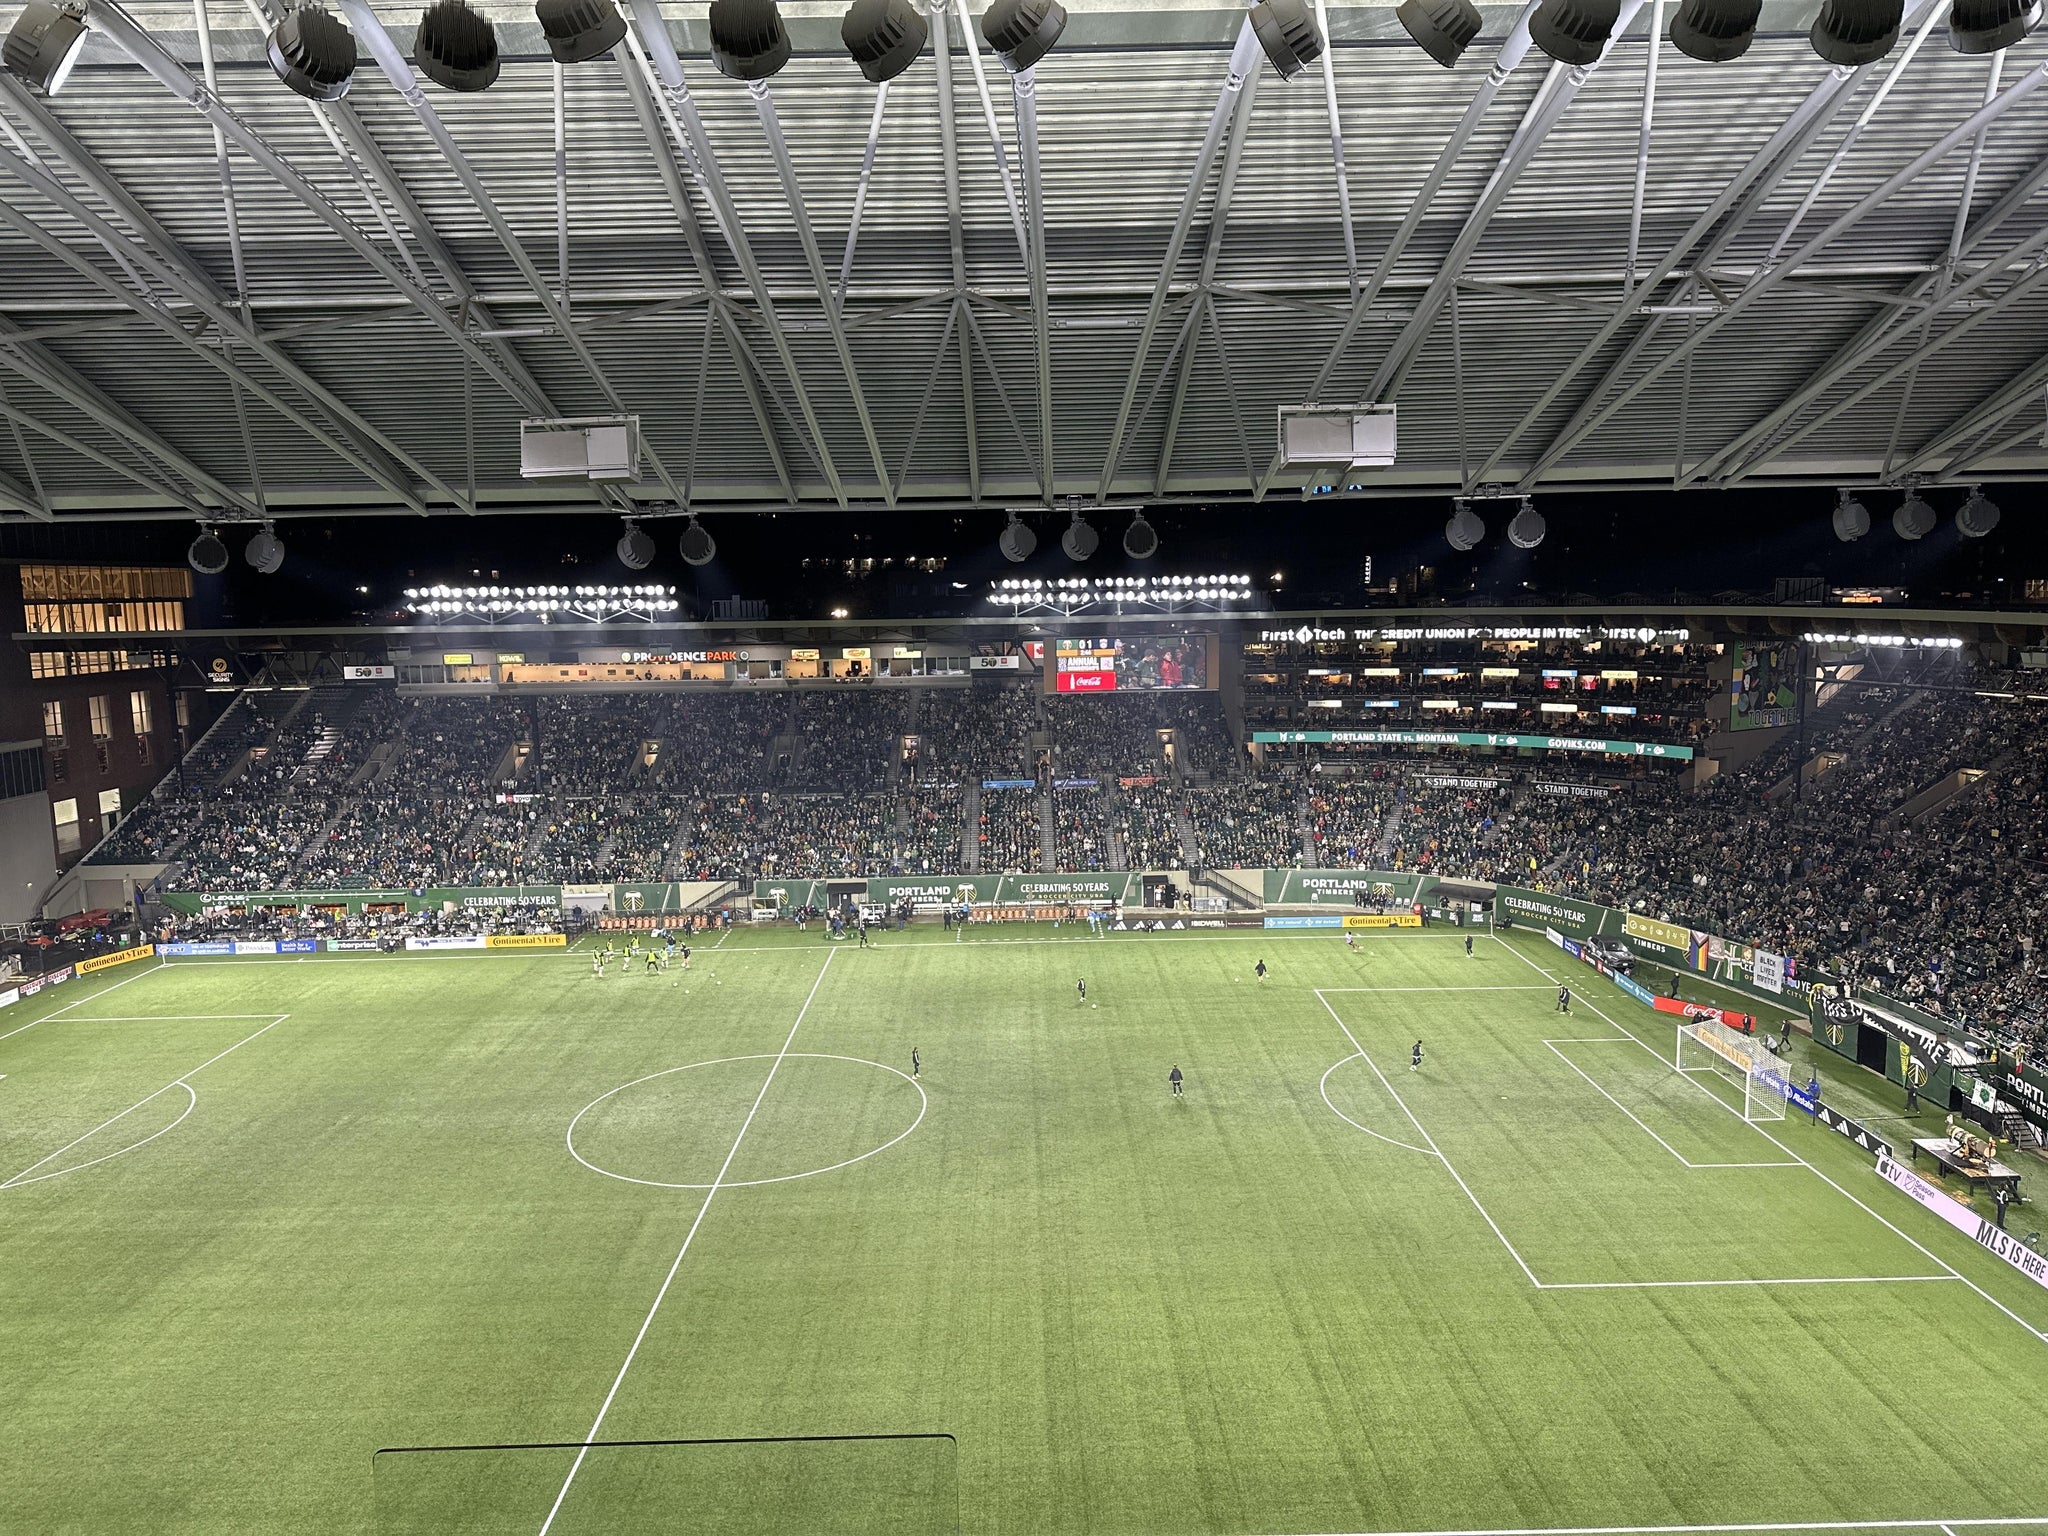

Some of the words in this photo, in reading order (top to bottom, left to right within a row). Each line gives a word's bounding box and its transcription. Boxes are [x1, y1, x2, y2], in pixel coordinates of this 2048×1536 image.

[1262, 628, 1294, 641] First
[1313, 628, 1346, 640] Tech
[1380, 629, 1424, 639] CREDIT
[1425, 628, 1466, 639] UNION
[1495, 628, 1541, 639] PEOPLE
[1542, 628, 1556, 638] IN
[1558, 627, 1591, 639] TEC
[706, 651, 737, 660] PARK
[1332, 732, 1376, 741] PORTLAND
[1377, 733, 1402, 741] STATE
[1416, 734, 1460, 743] MONTANA
[1548, 738, 1606, 750] GOVIKS.COM
[1433, 777, 1458, 787] STAND
[1459, 779, 1498, 789] TOGETHER
[1544, 784, 1569, 794] STAND
[1571, 786, 1609, 797] TOGETHER
[1021, 883, 1072, 893] CELEBRATING
[1073, 882, 1083, 892] 50
[1084, 882, 1110, 892] YEARS
[1303, 878, 1368, 889] PORTLAND
[889, 886, 951, 896] PORTLAND
[464, 896, 517, 907] CELEBRATING
[518, 896, 530, 906] 50
[530, 895, 556, 905] YEARS
[1505, 896, 1551, 915] CELEBRATING
[1553, 906, 1563, 917] 50
[1563, 909, 1586, 923] YEARS
[1350, 917, 1391, 925] Continental
[1521, 911, 1548, 921] SOCCER
[1550, 917, 1566, 926] CITY
[1567, 921, 1581, 929] USA
[493, 937, 536, 946] Continental
[1633, 937, 1666, 953] TIMBERS
[83, 953, 126, 971] Continental
[131, 947, 148, 956] Tire
[1760, 956, 1777, 968] BLACK
[1760, 966, 1776, 977] LIVES
[20, 977, 46, 994] DISCOUNT
[1756, 975, 1778, 987] MATTER
[1786, 990, 1802, 1000] CITY
[1822, 997, 1848, 1018] THIS
[2007, 1073, 2048, 1108] PORTL
[1793, 1093, 1815, 1111] Allstate
[2022, 1098, 2048, 1120] TIMBE
[1888, 1164, 1902, 1182] tv
[1912, 1188, 1925, 1201] Pass
[1914, 1180, 1935, 1198] Season
[1975, 1219, 2009, 1256] MLS
[2009, 1243, 2024, 1264] IS
[2021, 1251, 2047, 1280] HERE
